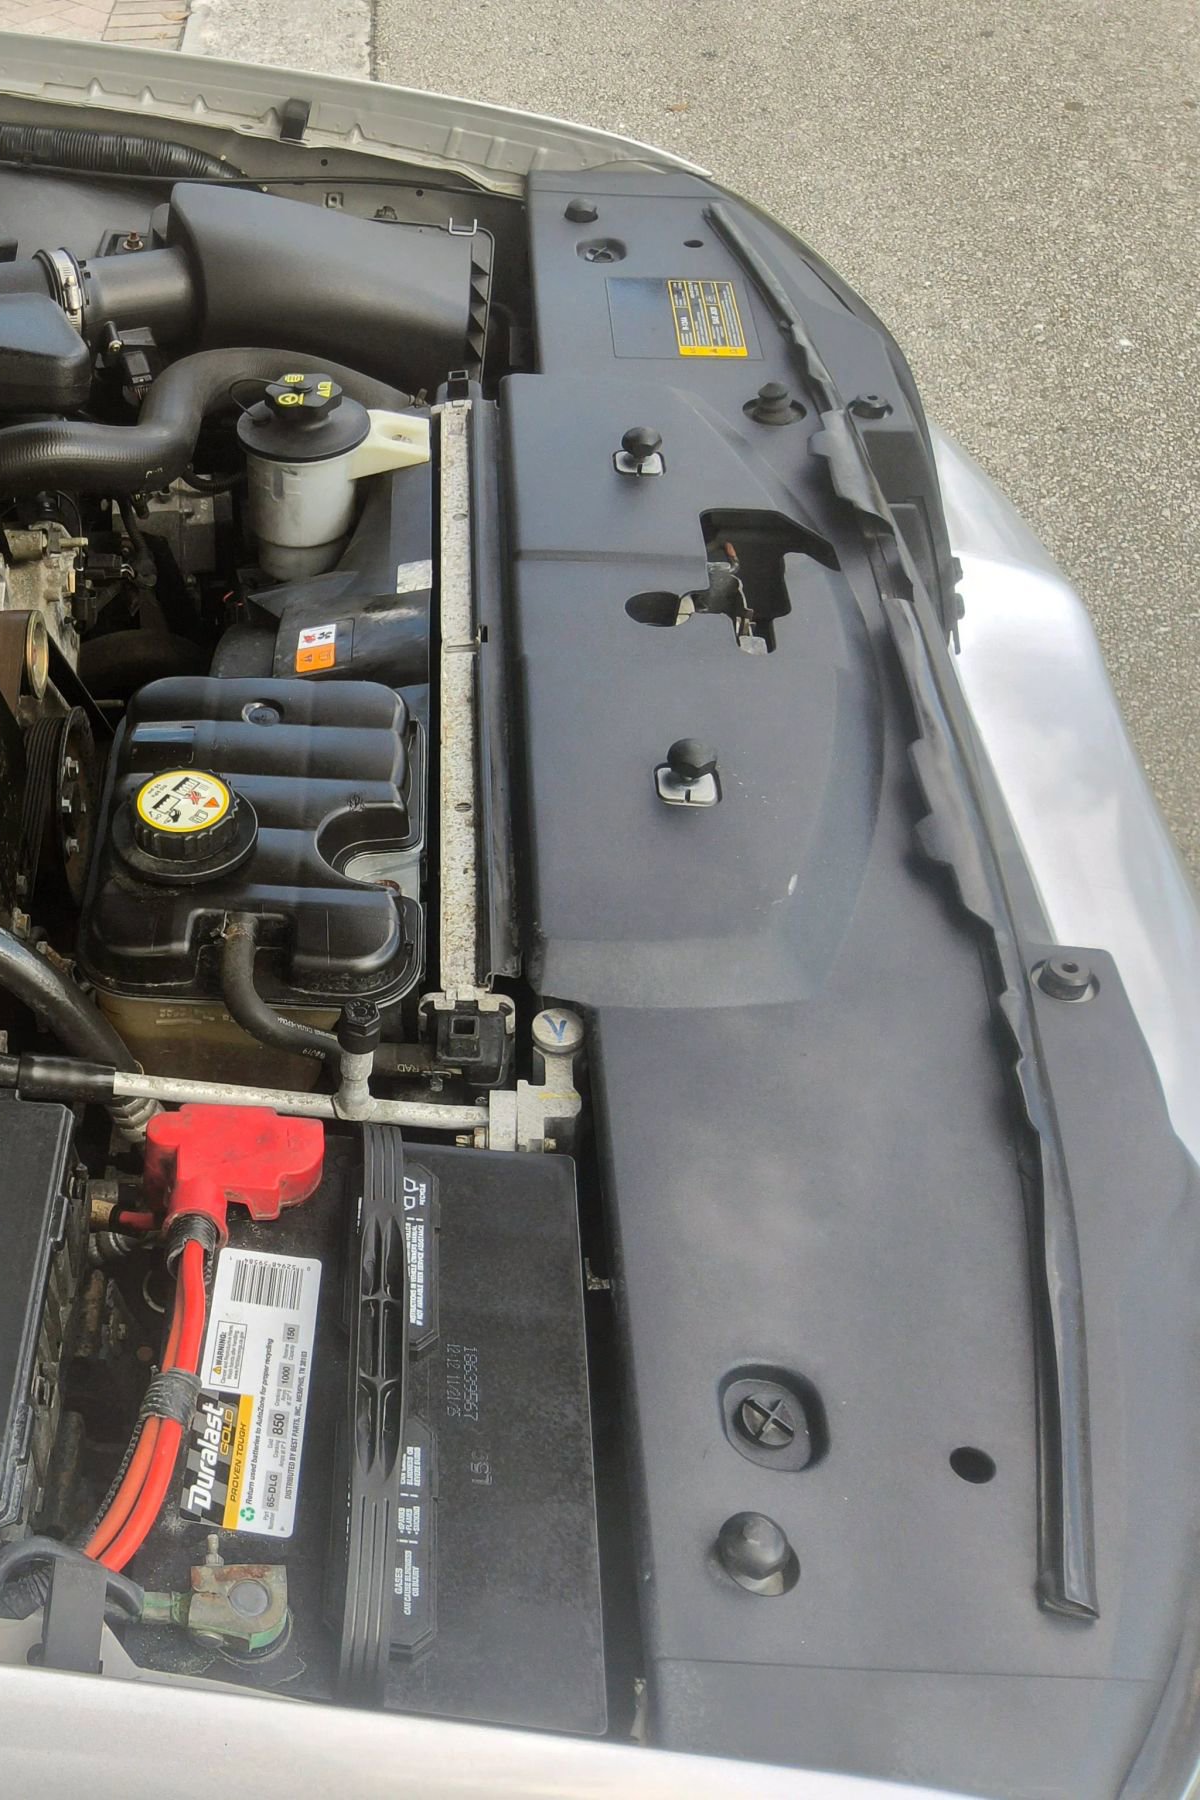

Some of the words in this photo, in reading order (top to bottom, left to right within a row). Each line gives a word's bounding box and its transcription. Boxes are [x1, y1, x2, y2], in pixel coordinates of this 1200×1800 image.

[286, 1327, 296, 1340] 150
[216, 1332, 226, 1365] WARNING:
[265, 1338, 274, 1365] recycling
[281, 1366, 291, 1384] 1000
[259, 1385, 267, 1395] for
[295, 1375, 305, 1403] MEMPHIS,
[255, 1396, 265, 1427] AutoZone
[272, 1413, 285, 1435] 850
[219, 1408, 234, 1455] GOLD
[291, 1417, 301, 1437] PARTS,
[188, 1404, 223, 1509] Duralast
[251, 1435, 260, 1463] batteries
[288, 1452, 296, 1461] BY
[290, 1437, 298, 1452] BEST
[230, 1458, 242, 1502] PROVEN
[236, 1422, 247, 1456] TOUGH
[245, 1481, 254, 1505] Return
[266, 1474, 278, 1508] 65-DLG
[284, 1461, 295, 1500] DISTRIBUTED
[394, 1567, 403, 1594] GASES
